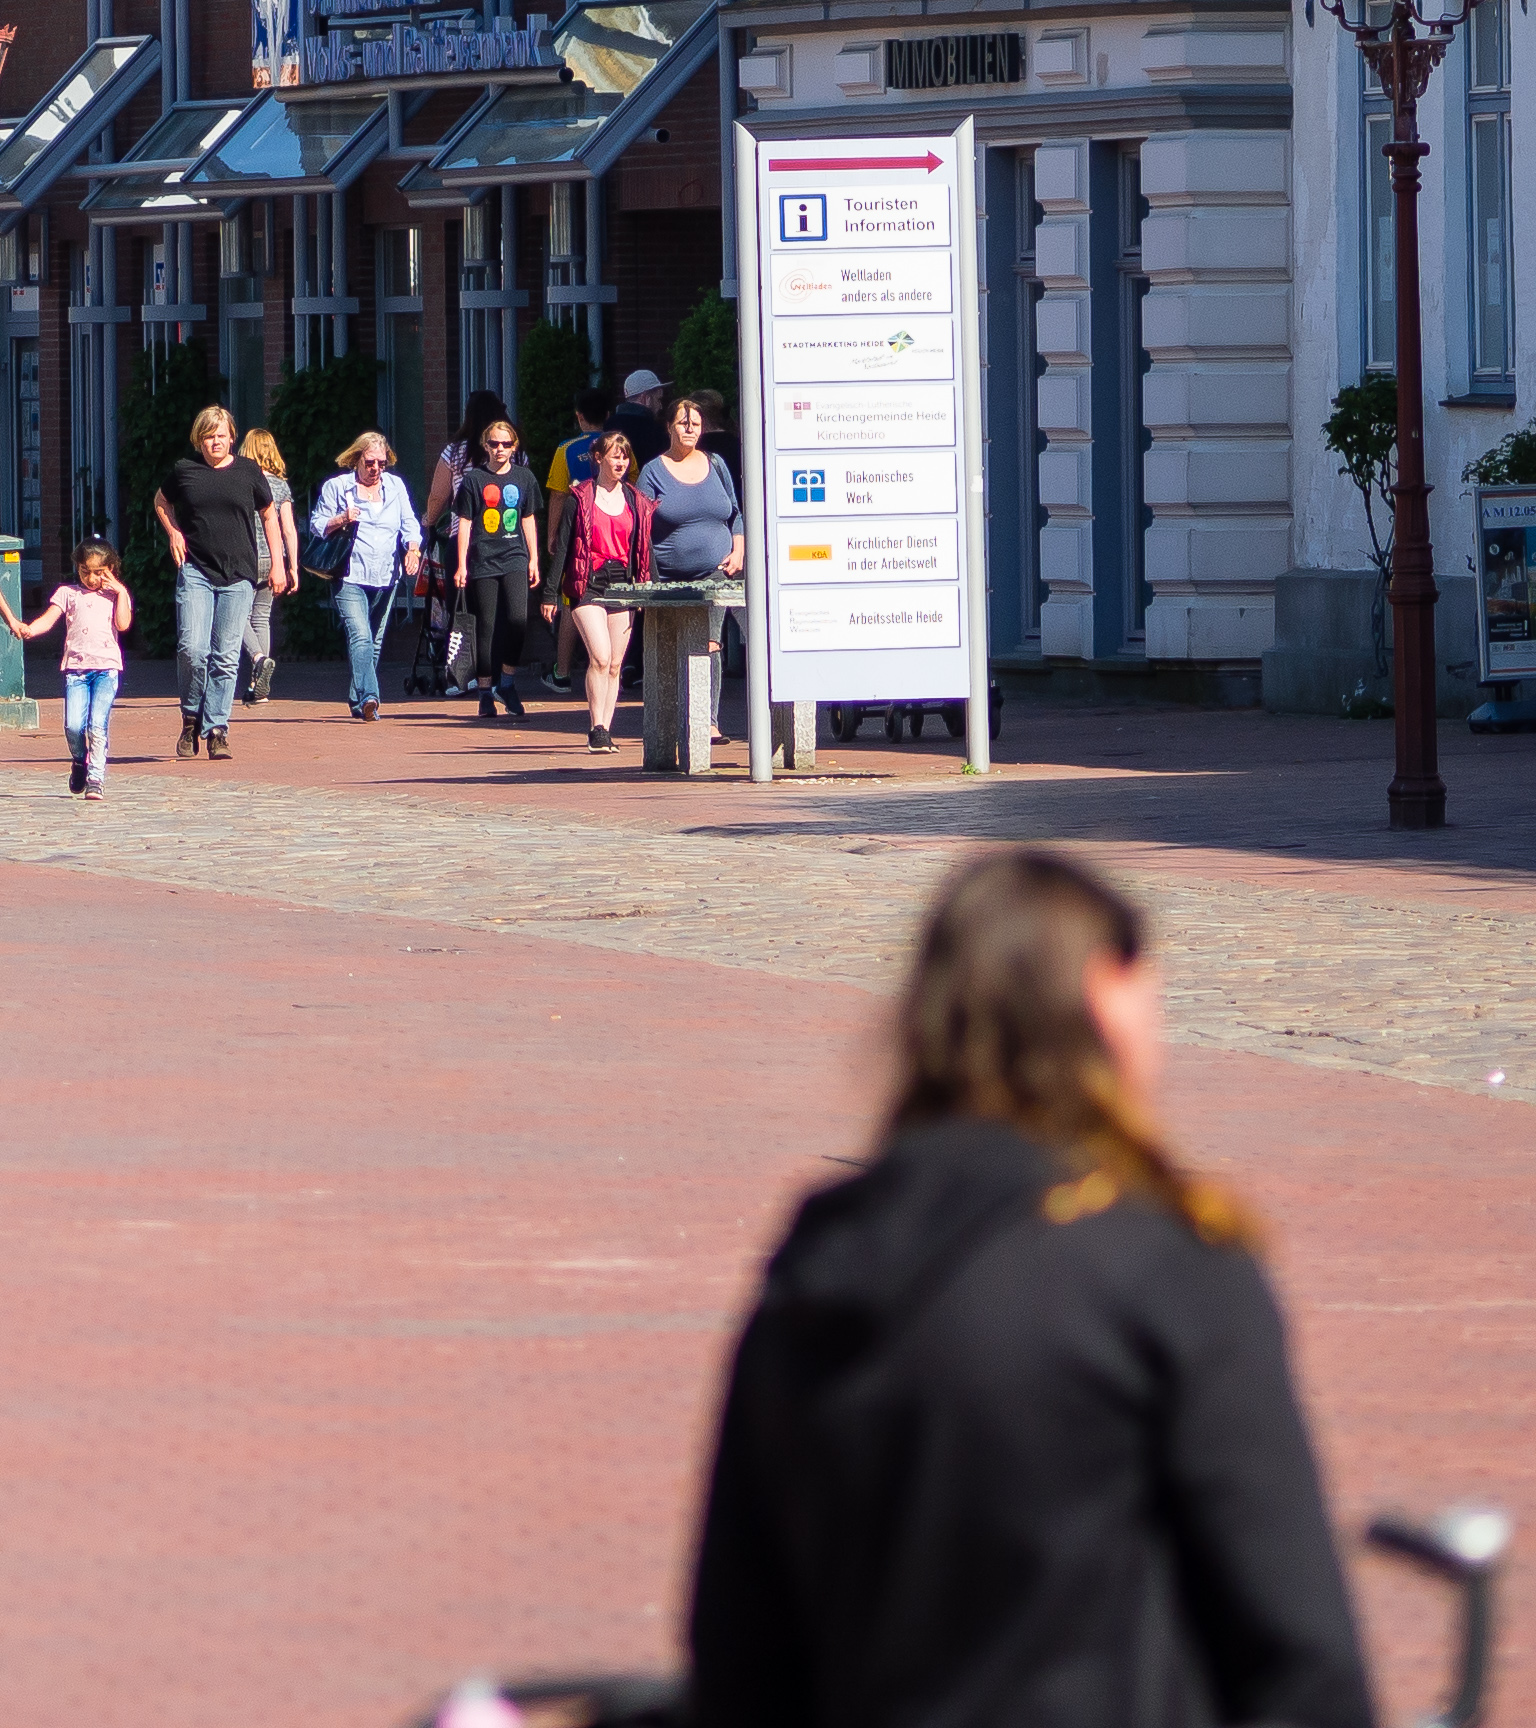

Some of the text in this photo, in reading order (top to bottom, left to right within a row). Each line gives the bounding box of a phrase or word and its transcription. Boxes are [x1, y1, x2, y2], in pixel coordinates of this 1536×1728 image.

[844, 197, 918, 212] Touristen
[844, 217, 936, 233] Information
[841, 268, 892, 282] Weltladen
[841, 289, 933, 303] anders als andere
[782, 341, 858, 349] STADTMARKETING
[816, 411, 947, 424] Kirchengemeinde Heide
[817, 429, 886, 441] Kirchenbüro
[845, 470, 914, 484] Diakonisches
[846, 491, 873, 504] Werk
[847, 535, 938, 550] Kirchlicher Dienst
[847, 556, 938, 571] in der Arbeitswelt
[849, 611, 913, 625] Arbeitsstelle
[916, 610, 943, 623] Heide
